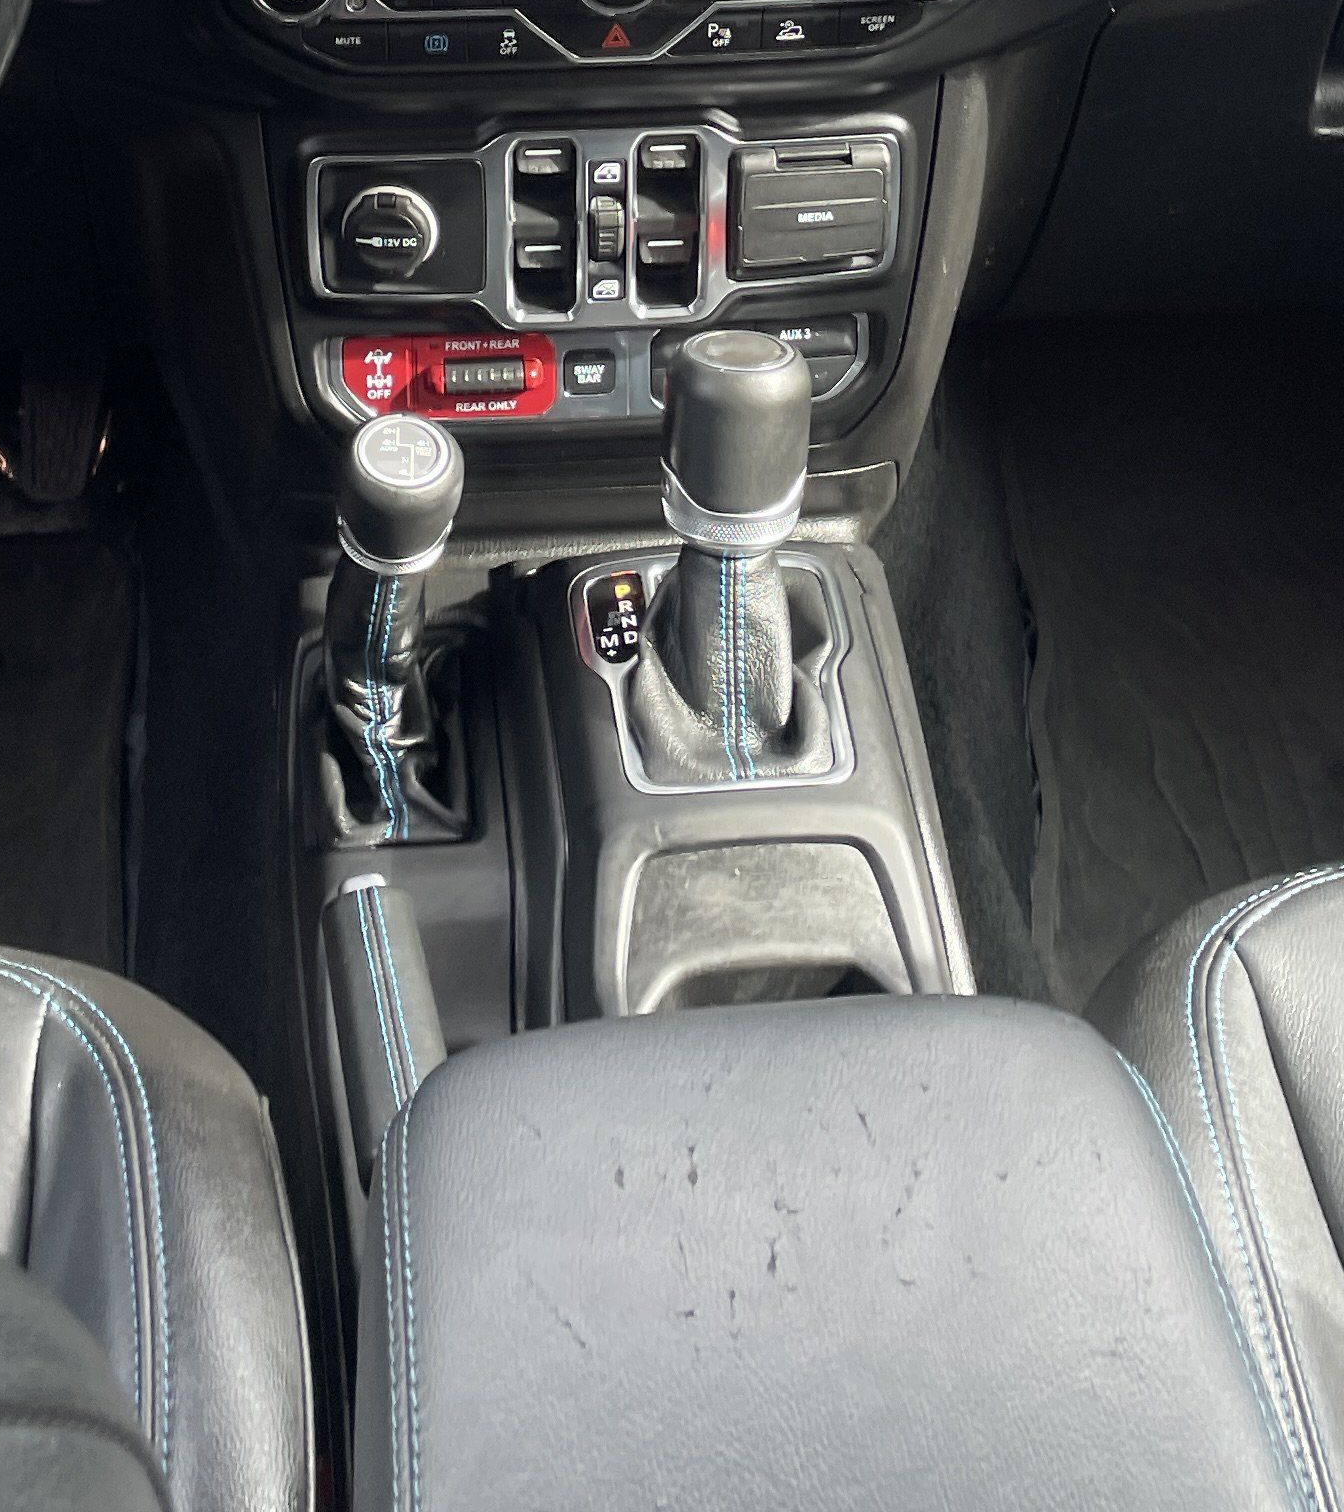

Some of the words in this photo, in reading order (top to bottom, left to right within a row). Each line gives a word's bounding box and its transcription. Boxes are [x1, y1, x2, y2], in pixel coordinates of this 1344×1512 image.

[860, 15, 895, 26] SCREEN
[868, 22, 886, 33] OFF
[334, 36, 362, 46] MUTE
[712, 38, 730, 47] OFF
[499, 46, 518, 56] OFF
[797, 210, 834, 223] MEDIA
[402, 237, 418, 247] DC
[779, 328, 803, 340] AUX
[803, 327, 812, 339] 3
[573, 365, 606, 376] SWAY
[577, 374, 602, 384] BAR
[366, 389, 392, 400] OFF
[455, 402, 486, 412] REAR
[488, 400, 517, 411] ONLY
[614, 584, 631, 599] P
[618, 600, 634, 613] R
[621, 615, 637, 628] N
[600, 633, 619, 648] M
[623, 631, 638, 644] D
